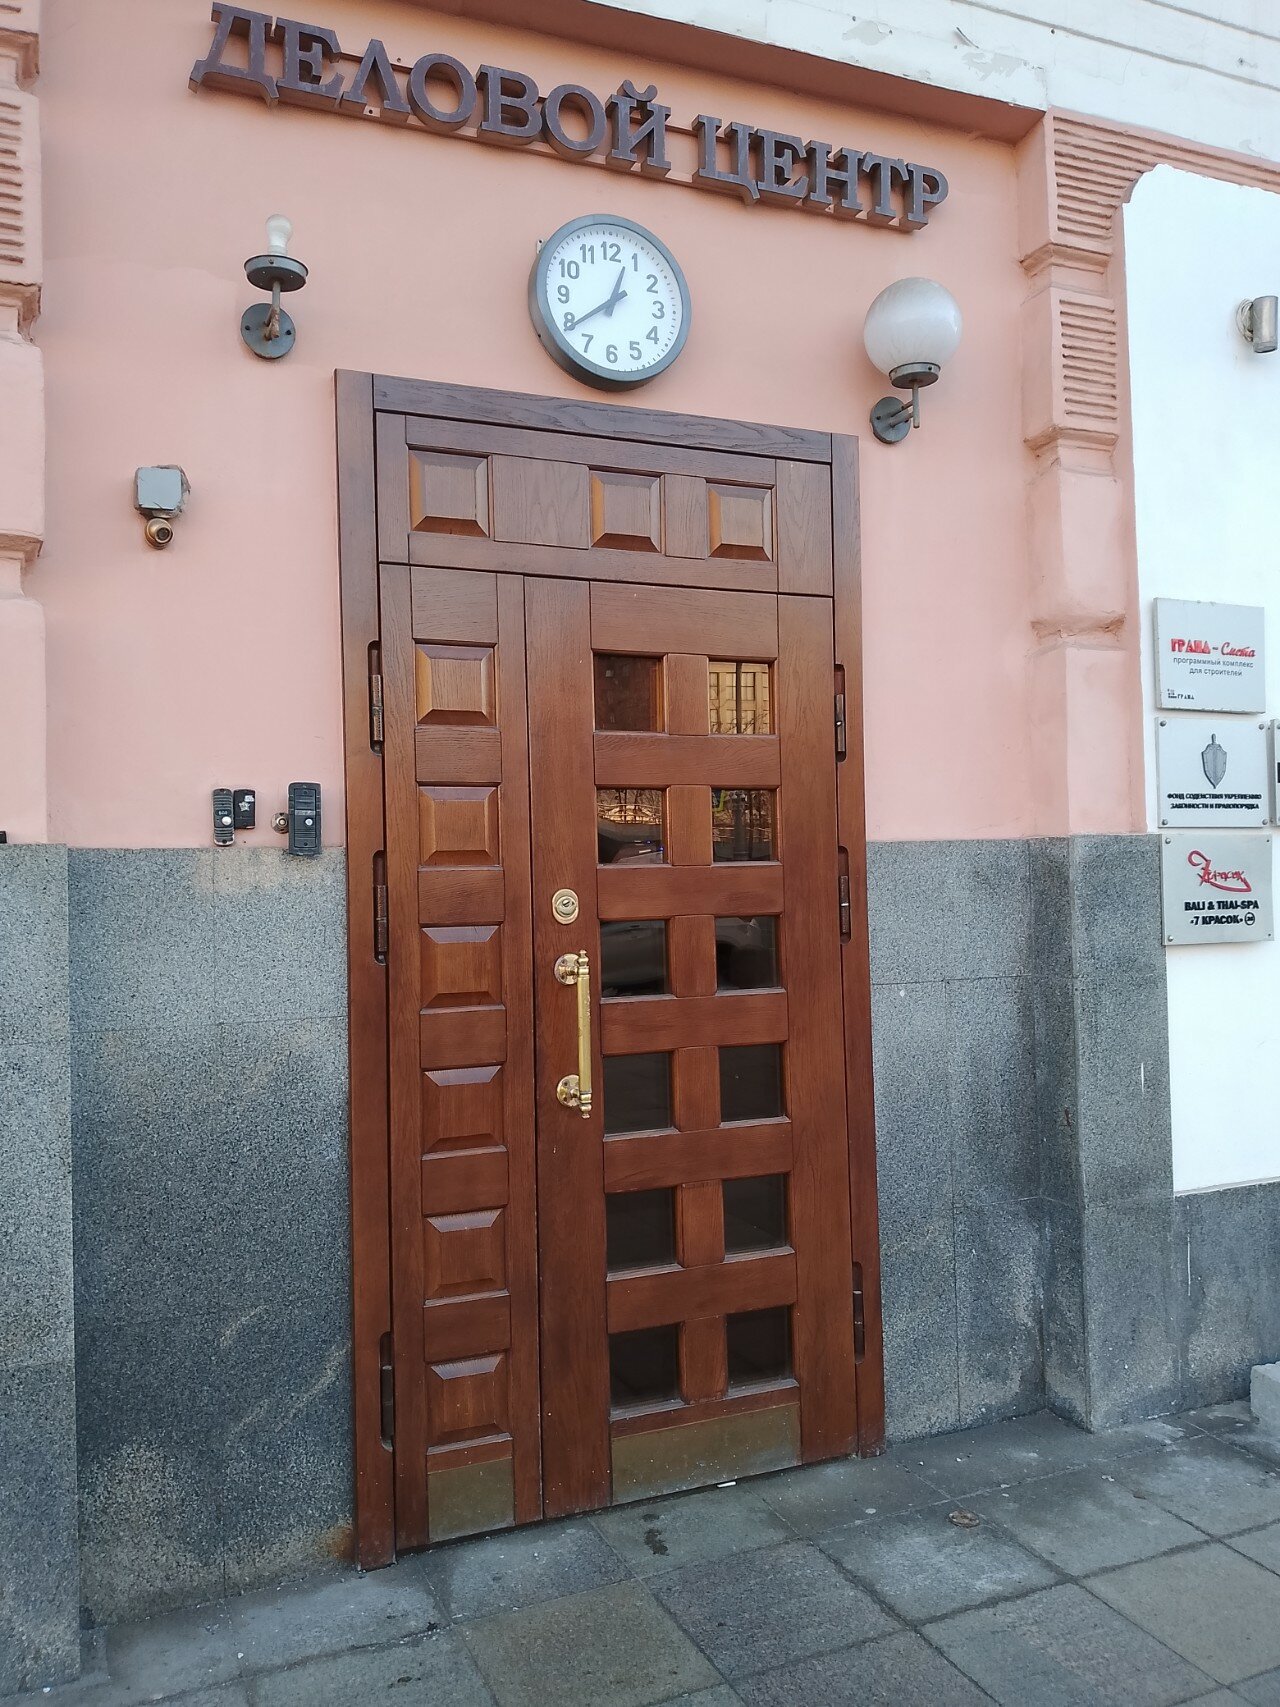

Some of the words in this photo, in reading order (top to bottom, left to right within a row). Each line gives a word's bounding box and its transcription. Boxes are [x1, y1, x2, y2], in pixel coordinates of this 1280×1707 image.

[189, 2, 673, 171] ДЕЛОВОЙ
[692, 113, 949, 228] ЦЕНТР
[579, 243, 595, 265] 11
[601, 241, 622, 264] 12
[631, 252, 639, 272] 1
[558, 258, 580, 280] 10
[646, 273, 659, 294] 2
[557, 284, 570, 304] 9
[651, 300, 666, 320] 3
[563, 311, 576, 331] 8
[581, 333, 594, 353] 7
[645, 325, 660, 345] 4
[605, 344, 618, 363] 6
[629, 340, 643, 360] 5
[1173, 657, 1221, 667] программный
[1203, 668, 1243, 677] строителей
[1184, 901, 1206, 911] BALI
[1207, 901, 1215, 910] &
[1216, 900, 1260, 910] THAI-SPA
